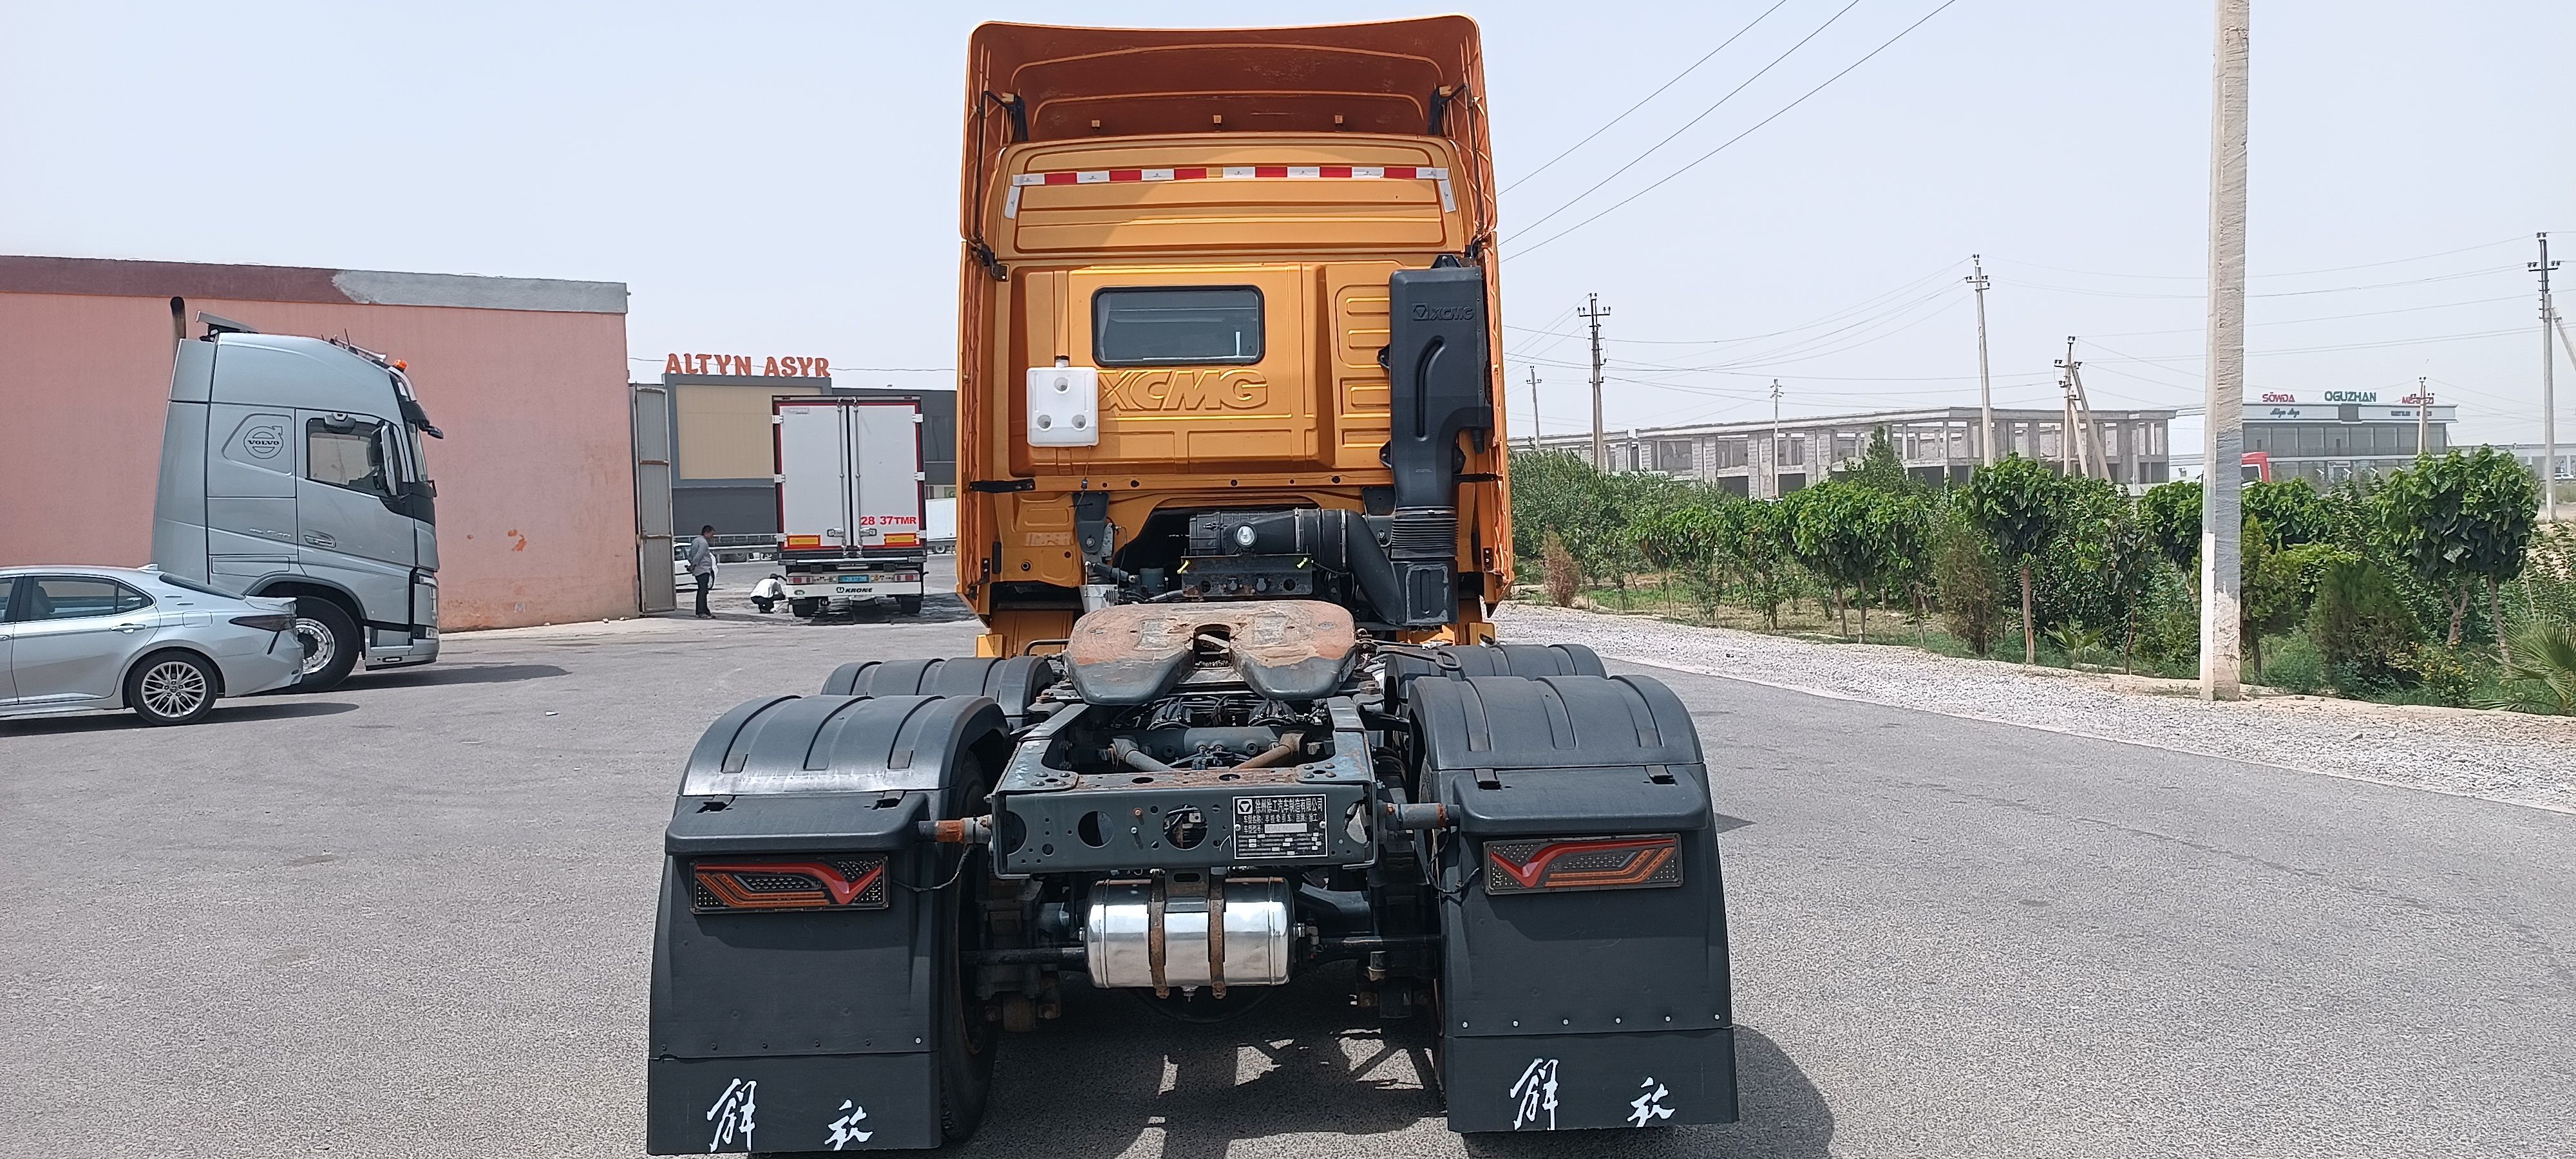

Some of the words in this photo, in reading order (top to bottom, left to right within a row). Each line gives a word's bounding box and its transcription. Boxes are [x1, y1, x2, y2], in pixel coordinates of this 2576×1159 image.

[1430, 306, 1475, 321] XCMG
[665, 353, 752, 375] ALTYN
[764, 356, 831, 377] ASYR
[1097, 368, 1268, 411] XCMG
[2262, 391, 2295, 402] SÖWDA
[2324, 391, 2376, 402] OGUZHAN
[861, 516, 875, 525] 28
[1255, 797, 1323, 814] 徐州徐工汽车制造有限公司
